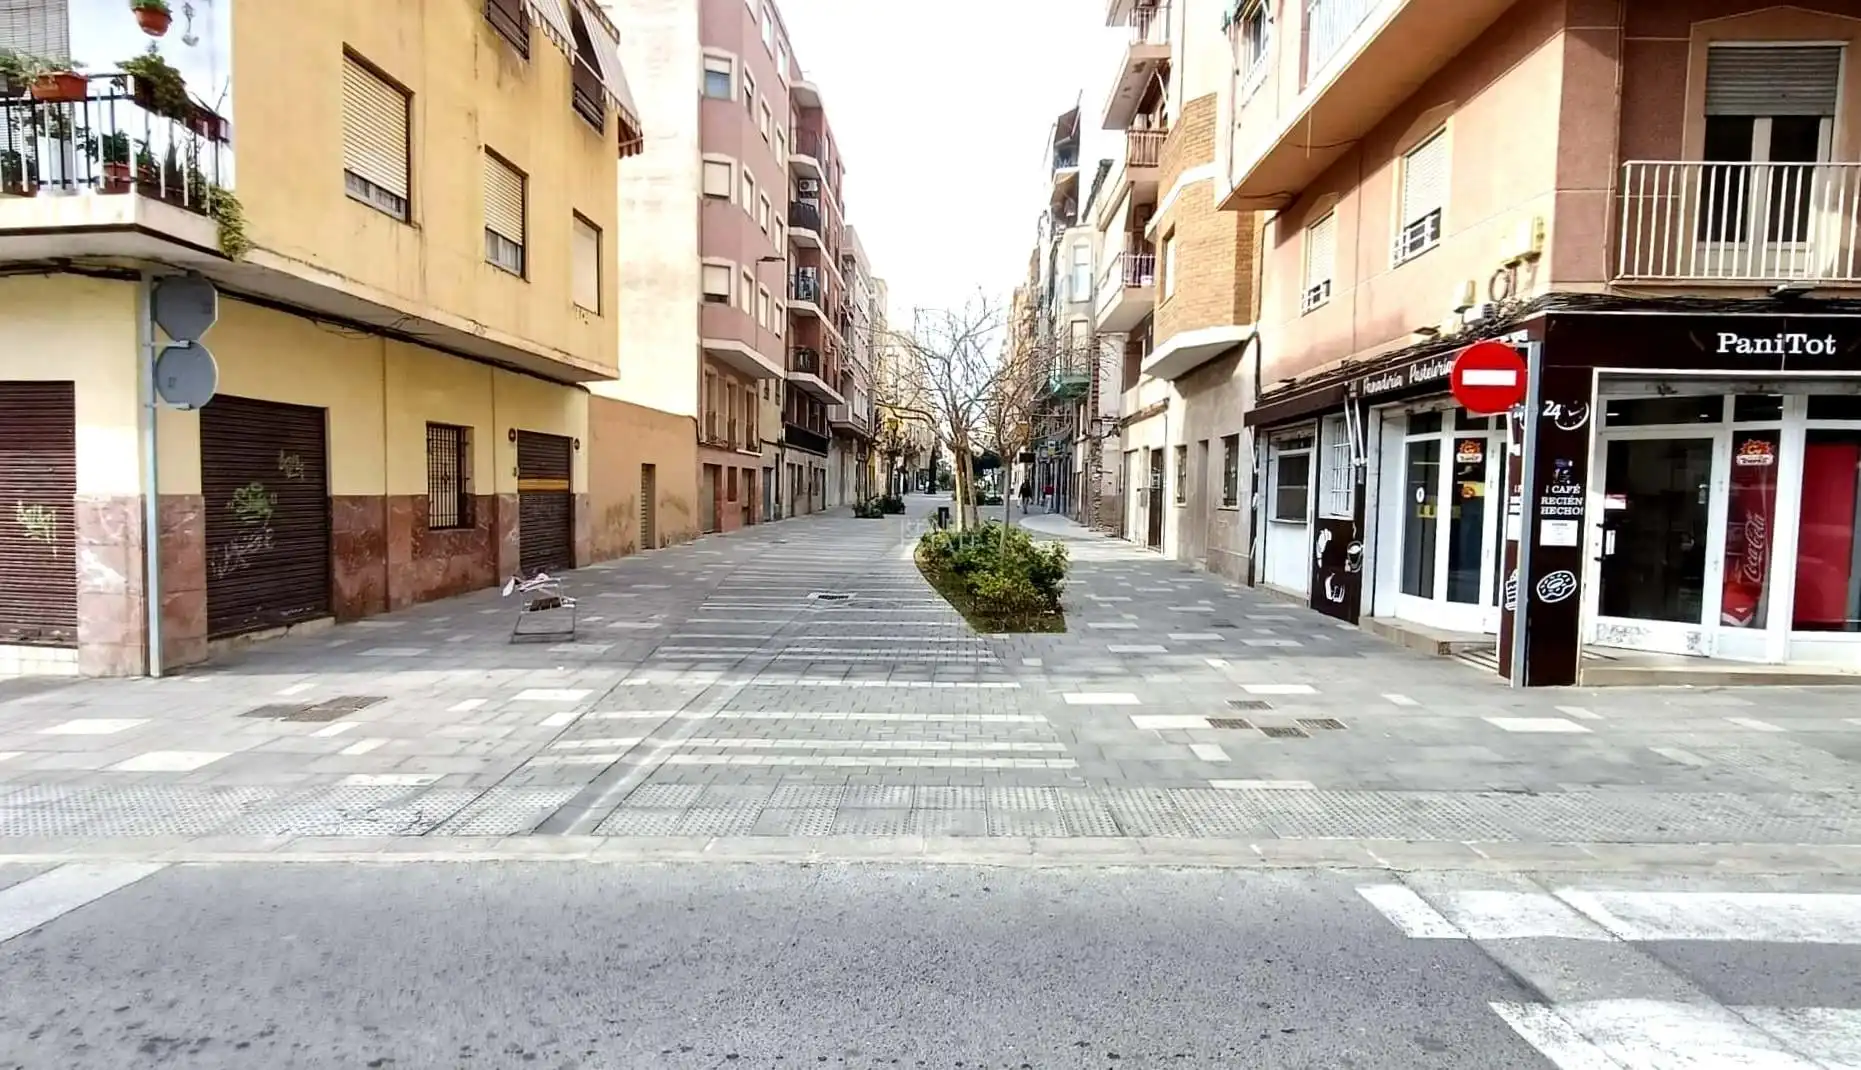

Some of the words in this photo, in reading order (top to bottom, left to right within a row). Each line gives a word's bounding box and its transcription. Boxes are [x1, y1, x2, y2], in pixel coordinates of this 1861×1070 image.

[1716, 332, 1836, 355] PaniTot
[1543, 401, 1561, 420] 24
[1540, 495, 1583, 506] RECIÉN
[1540, 506, 1584, 516] HECHO!
